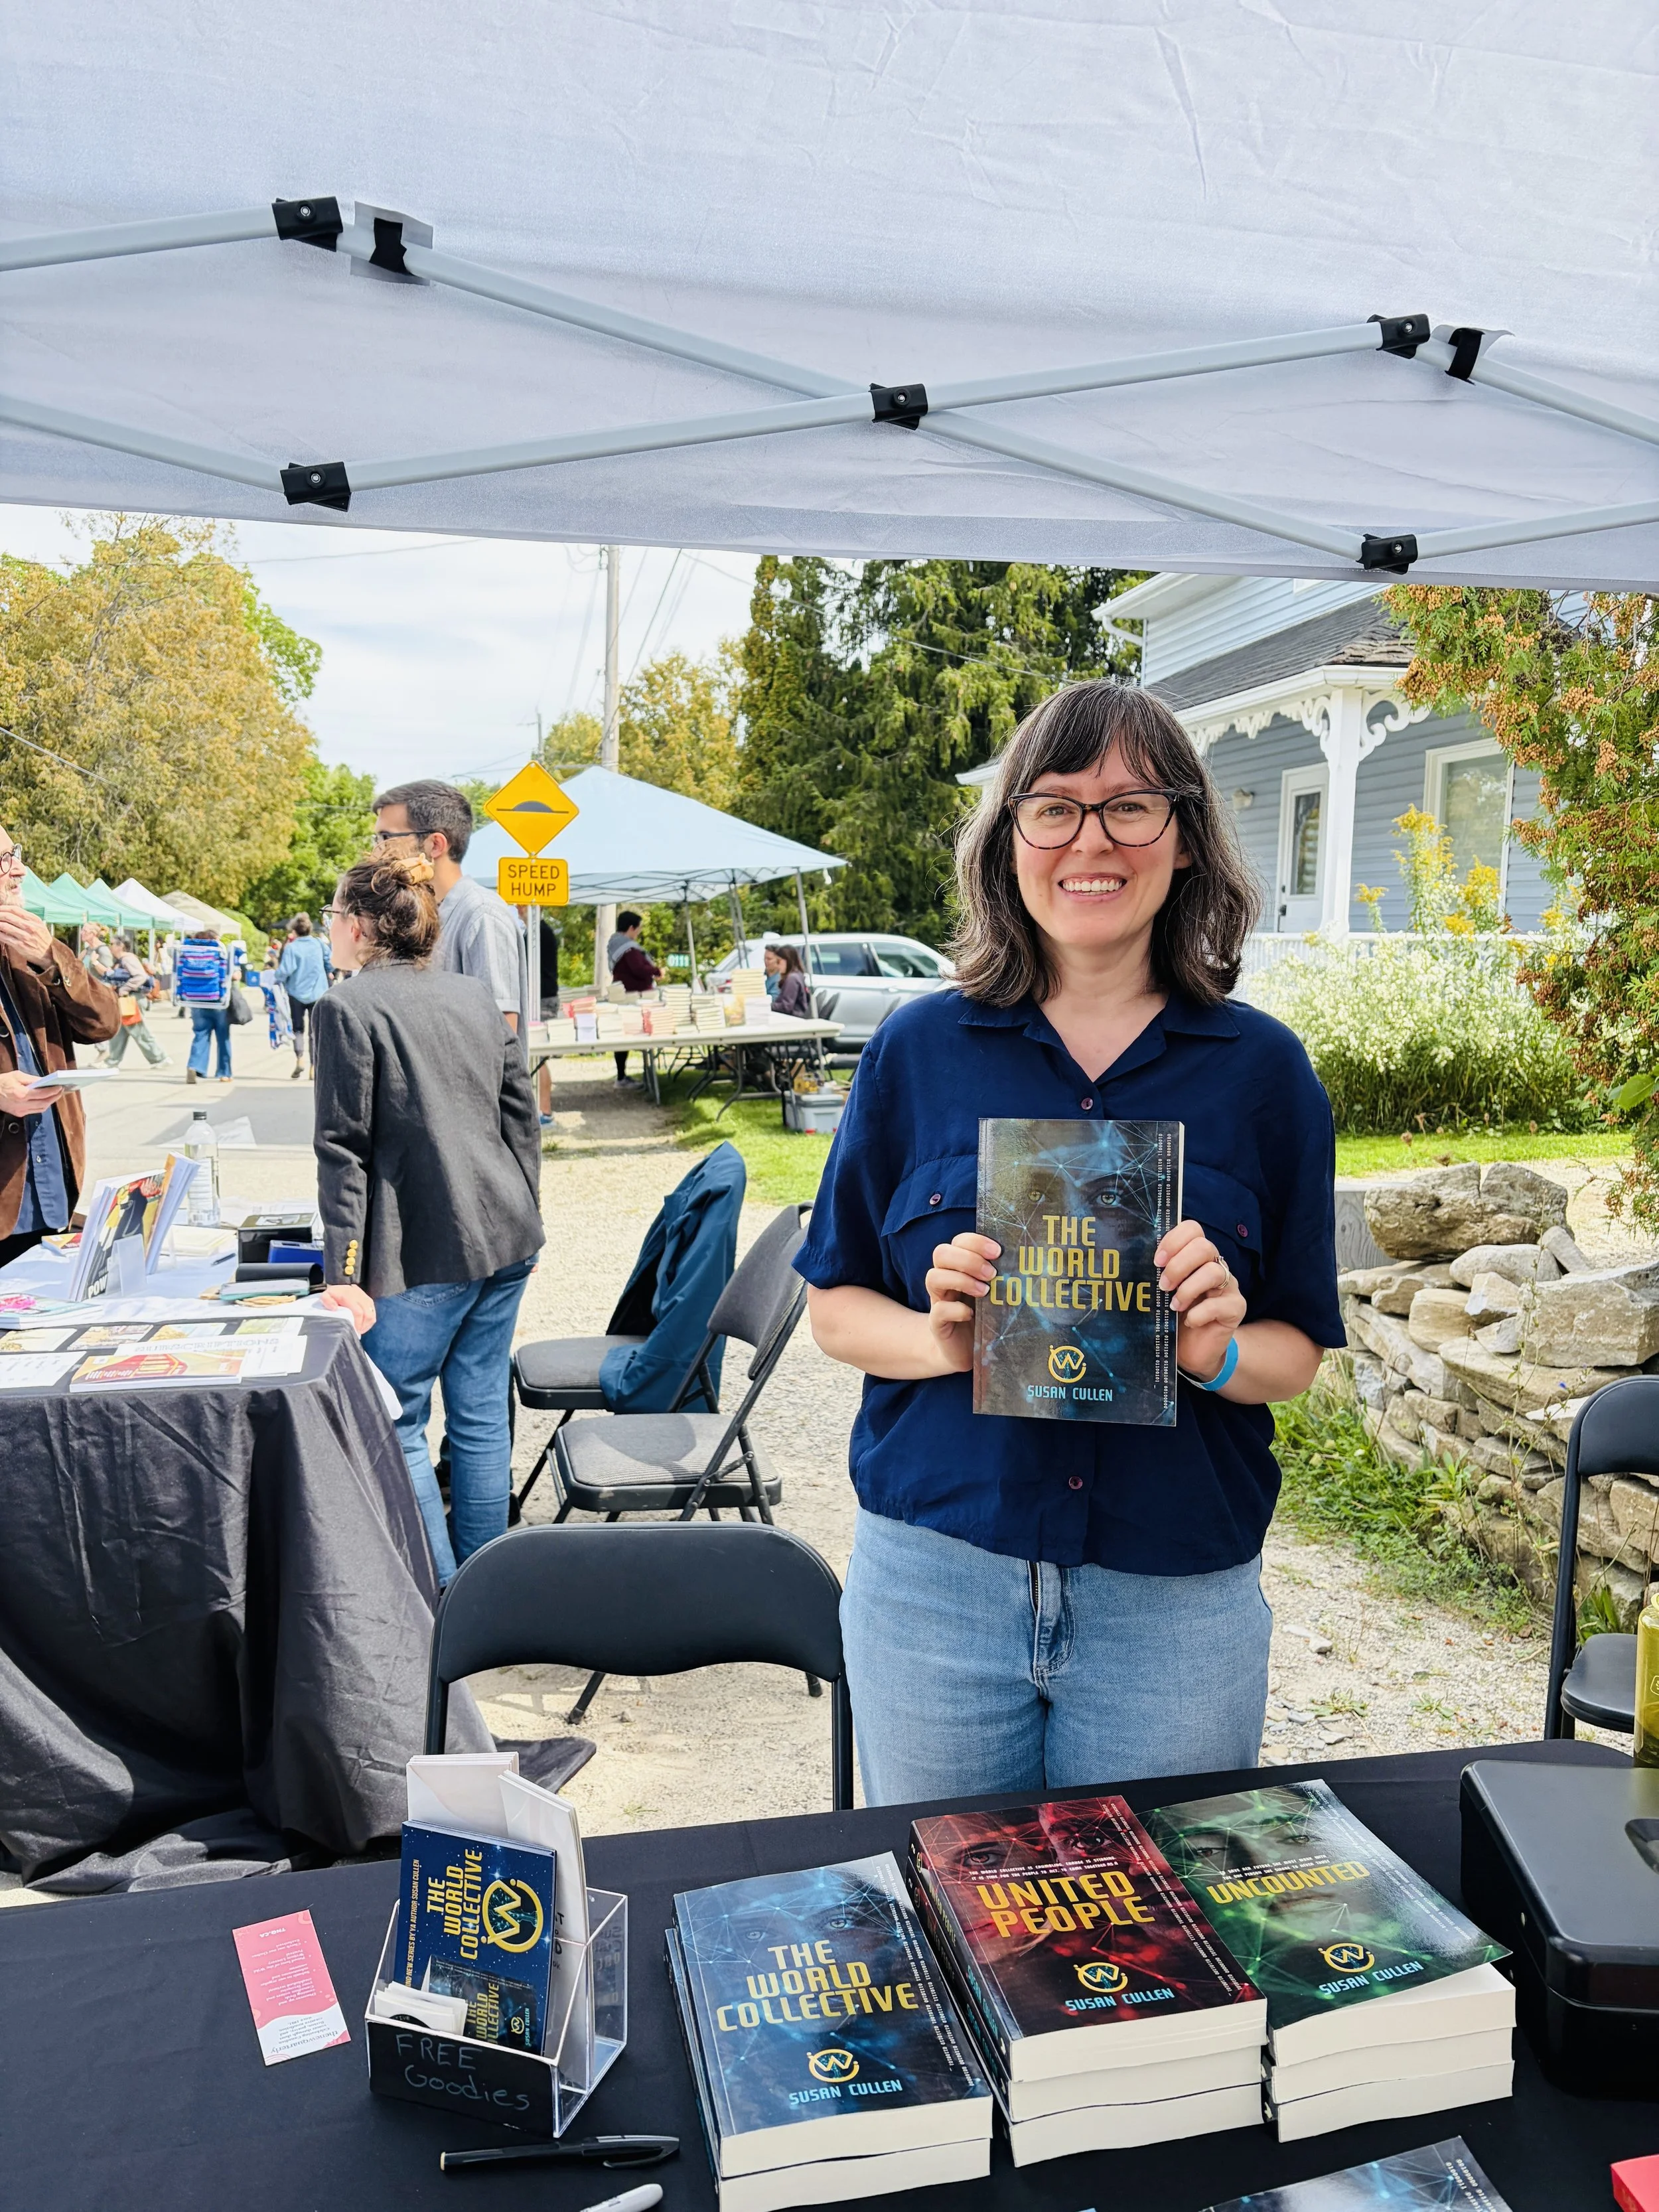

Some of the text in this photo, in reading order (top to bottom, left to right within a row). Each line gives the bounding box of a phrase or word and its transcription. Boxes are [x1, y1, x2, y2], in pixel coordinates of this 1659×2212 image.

[508, 864, 559, 879] SPEED
[512, 882, 556, 897] HUMP
[1042, 1215, 1096, 1246] THE
[1019, 1246, 1119, 1279] WORLD
[88, 1274, 108, 1299] POW
[990, 1276, 1151, 1312] COLLECTIVE
[135, 1337, 279, 1353] SUBSCRIPTIONS
[1027, 1385, 1066, 1399] SUSAN
[1072, 1387, 1113, 1402] CULLEN
[427, 1877, 445, 1913] THE
[975, 1870, 1135, 1910] UNITED
[1206, 1860, 1370, 1904] UNCOUNTED
[443, 1866, 464, 1935] WORLD
[461, 1849, 482, 1960] COLLECTIVE
[930, 1880, 956, 1947] UNITED PEOPLE
[990, 1895, 1155, 1938] PEOPLE
[259, 1927, 285, 1937] TNQ.CA
[409, 1932, 415, 1941] BY
[768, 1939, 836, 1970] THE
[746, 1961, 871, 2000] WORLD
[1319, 1960, 1425, 1996] SUSAN CULLEN
[476, 1992, 488, 2039] WORLD
[488, 1982, 499, 2044] LLECTIVE
[716, 1982, 919, 2031] COLLECTIVE
[968, 1964, 999, 2040] SUSAN CULLEN
[1065, 1988, 1175, 2012] SUSAN CULLEN
[269, 2031, 338, 2054] thenewquarterly
[396, 2033, 482, 2070] FREE
[405, 2064, 530, 2110] Goodies
[788, 2079, 903, 2105] SUSAN CULLEN
